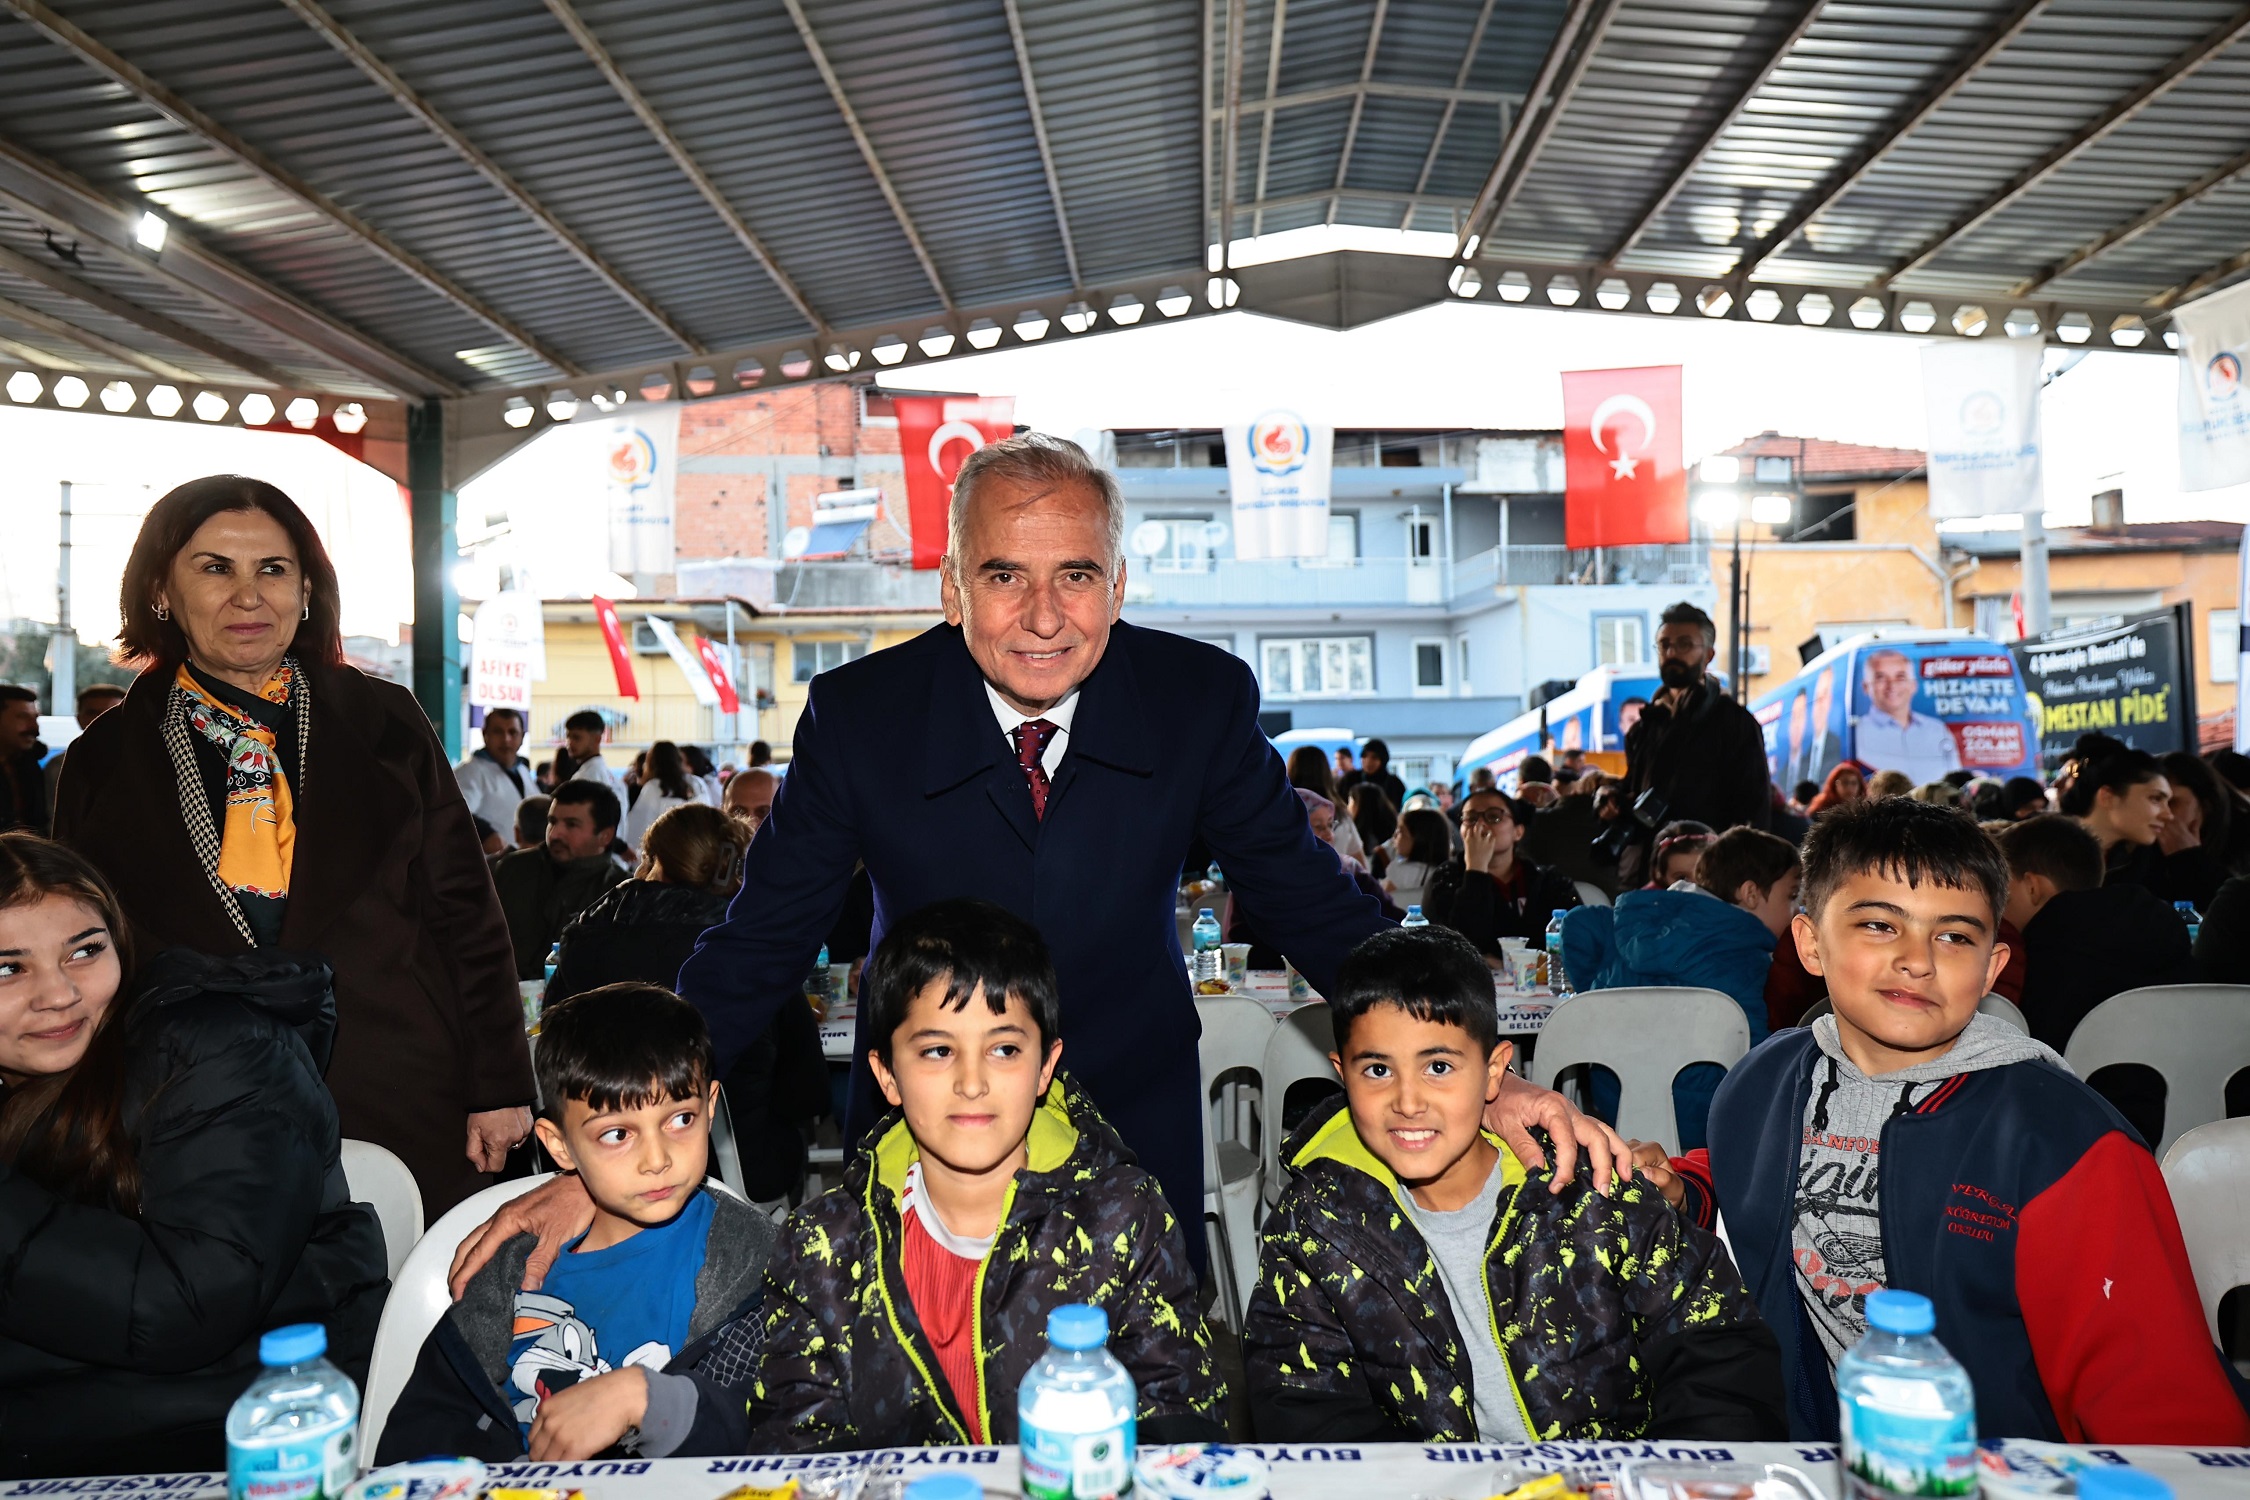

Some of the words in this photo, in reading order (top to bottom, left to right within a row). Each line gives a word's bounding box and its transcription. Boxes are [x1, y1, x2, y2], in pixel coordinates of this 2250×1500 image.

[479, 683, 523, 702] OLSUN
[1935, 697, 2011, 716] DEVAM
[2045, 698, 2117, 733] MESTAN
[1948, 1222, 1995, 1241] OKULU
